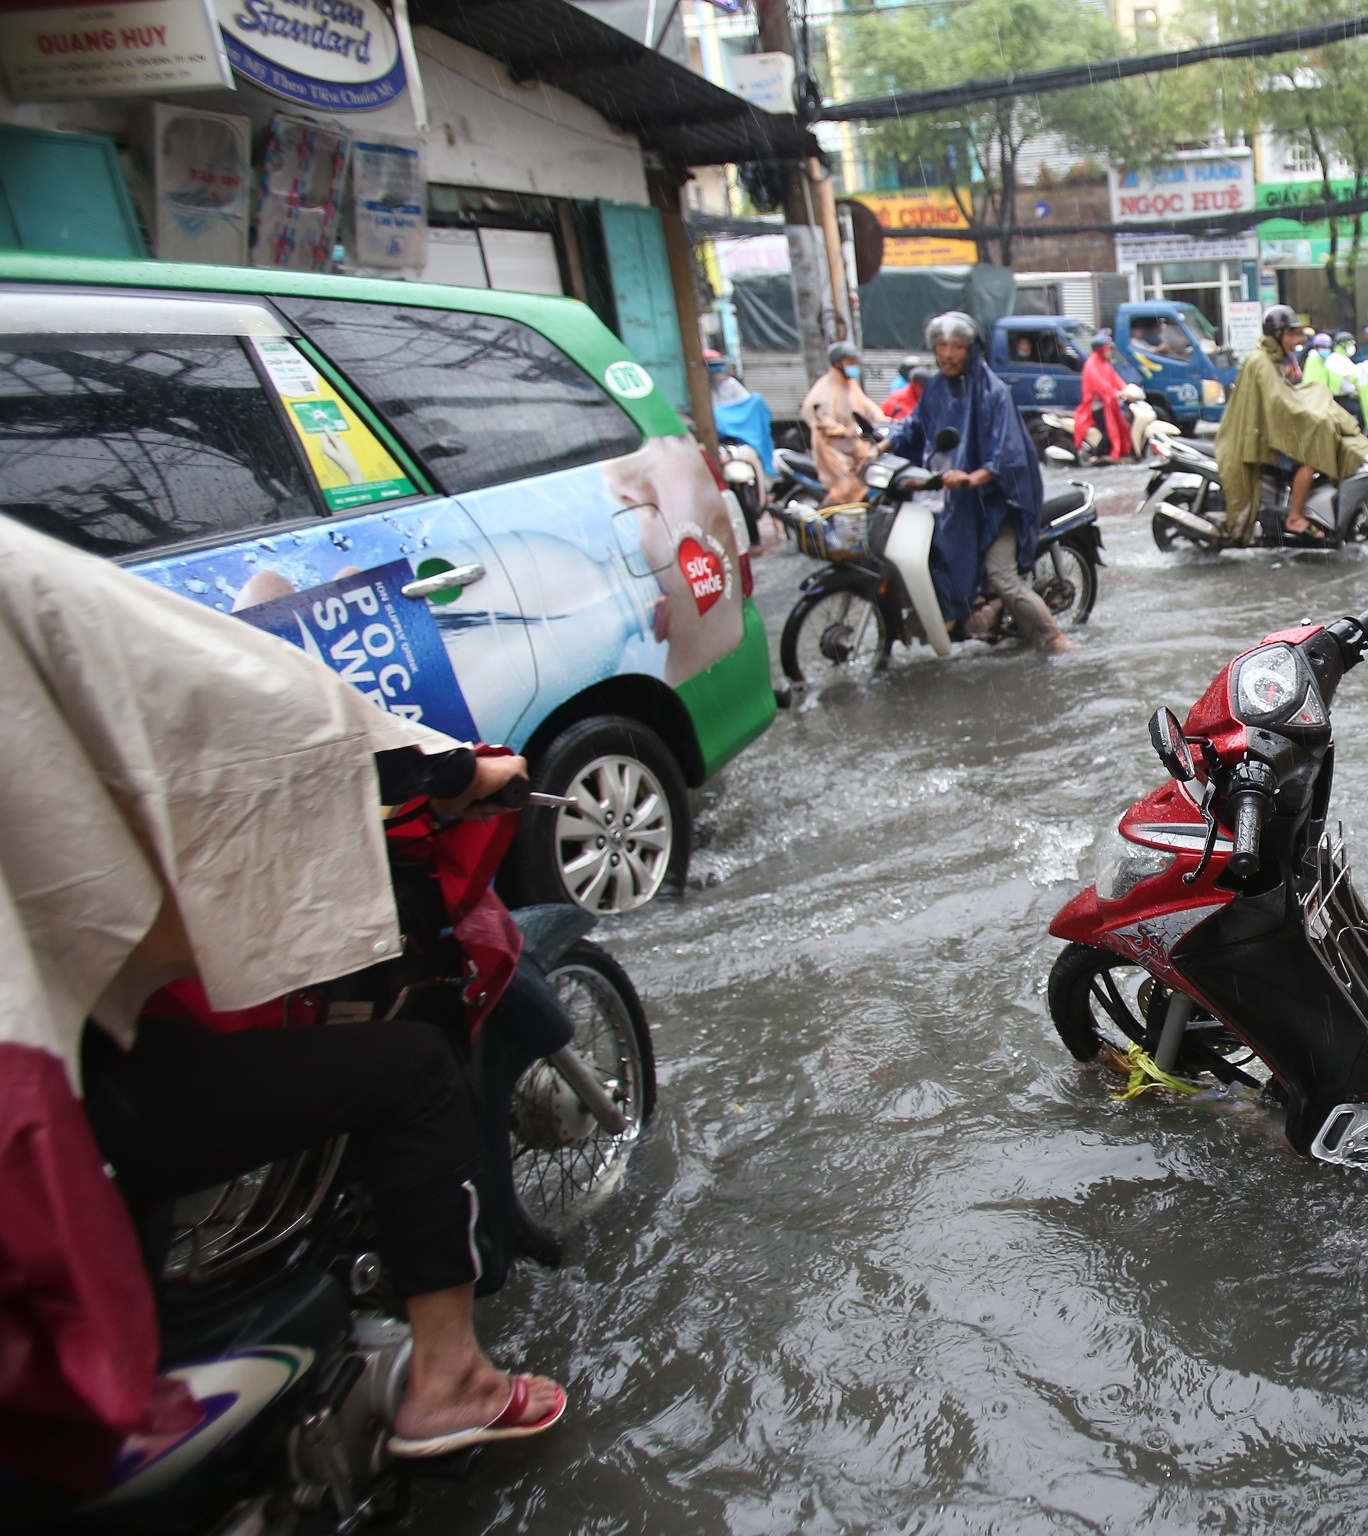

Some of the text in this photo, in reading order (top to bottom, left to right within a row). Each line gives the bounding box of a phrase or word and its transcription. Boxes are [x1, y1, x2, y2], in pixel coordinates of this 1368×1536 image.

[235, 0, 372, 64] Standard
[1120, 184, 1244, 217] NGỌC HUỆ
[375, 581, 390, 602] ION
